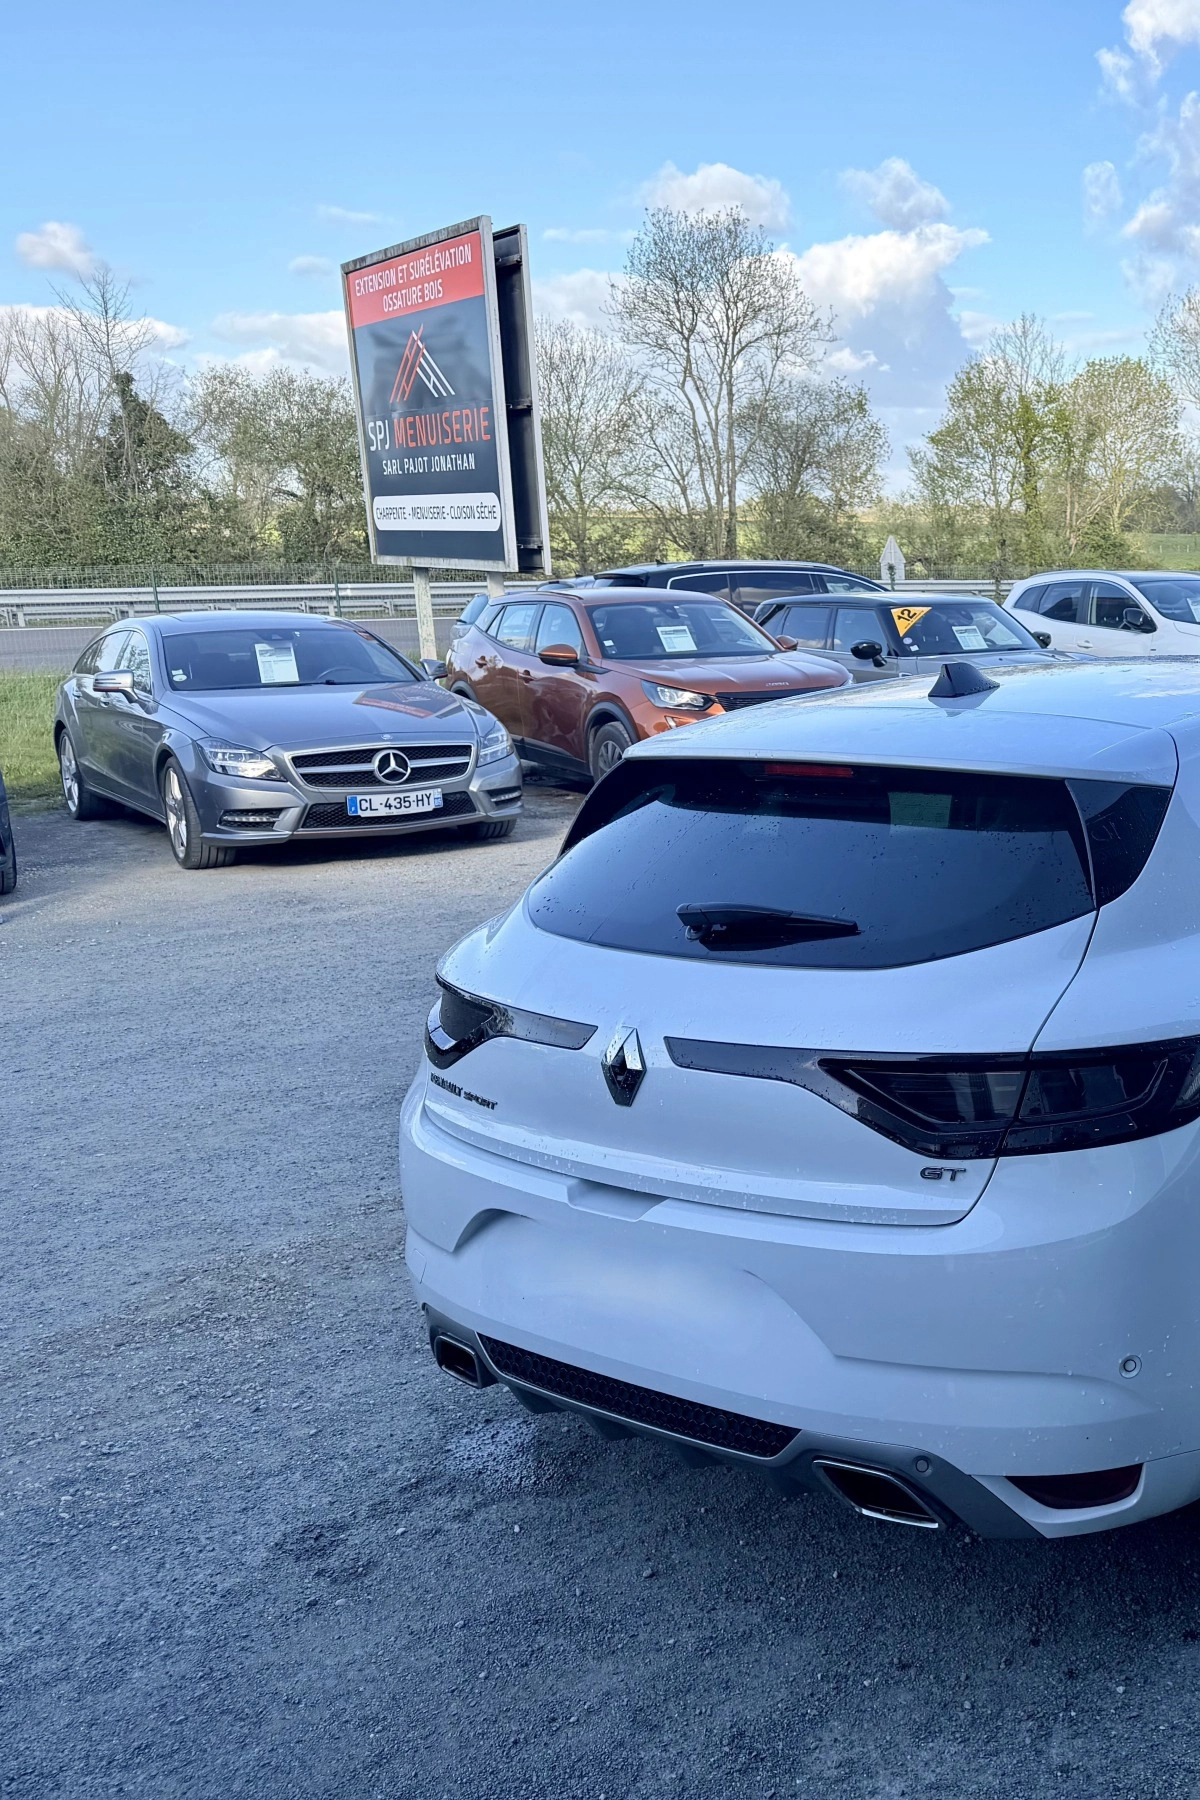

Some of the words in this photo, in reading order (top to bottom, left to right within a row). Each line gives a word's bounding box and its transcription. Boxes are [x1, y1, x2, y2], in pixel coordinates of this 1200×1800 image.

[355, 268, 396, 296] EXTENSION
[398, 264, 407, 283] ET
[409, 243, 472, 280] SURÉLÉVATION
[383, 285, 423, 312] OSSATURE
[424, 279, 442, 301] BOIS
[368, 420, 390, 451] SPJ
[394, 407, 491, 449] MENUISERIE
[383, 459, 402, 475] SARL
[404, 457, 428, 474] PAJOT
[431, 453, 475, 472] JONATHAN
[376, 507, 407, 520] CHARPENTE
[412, 506, 446, 519] MENUISERIE
[450, 506, 475, 519] CLOISON
[897, 609, 917, 621] 12
[359, 793, 432, 811] CL-435-HY
[920, 1167, 966, 1181] GT
